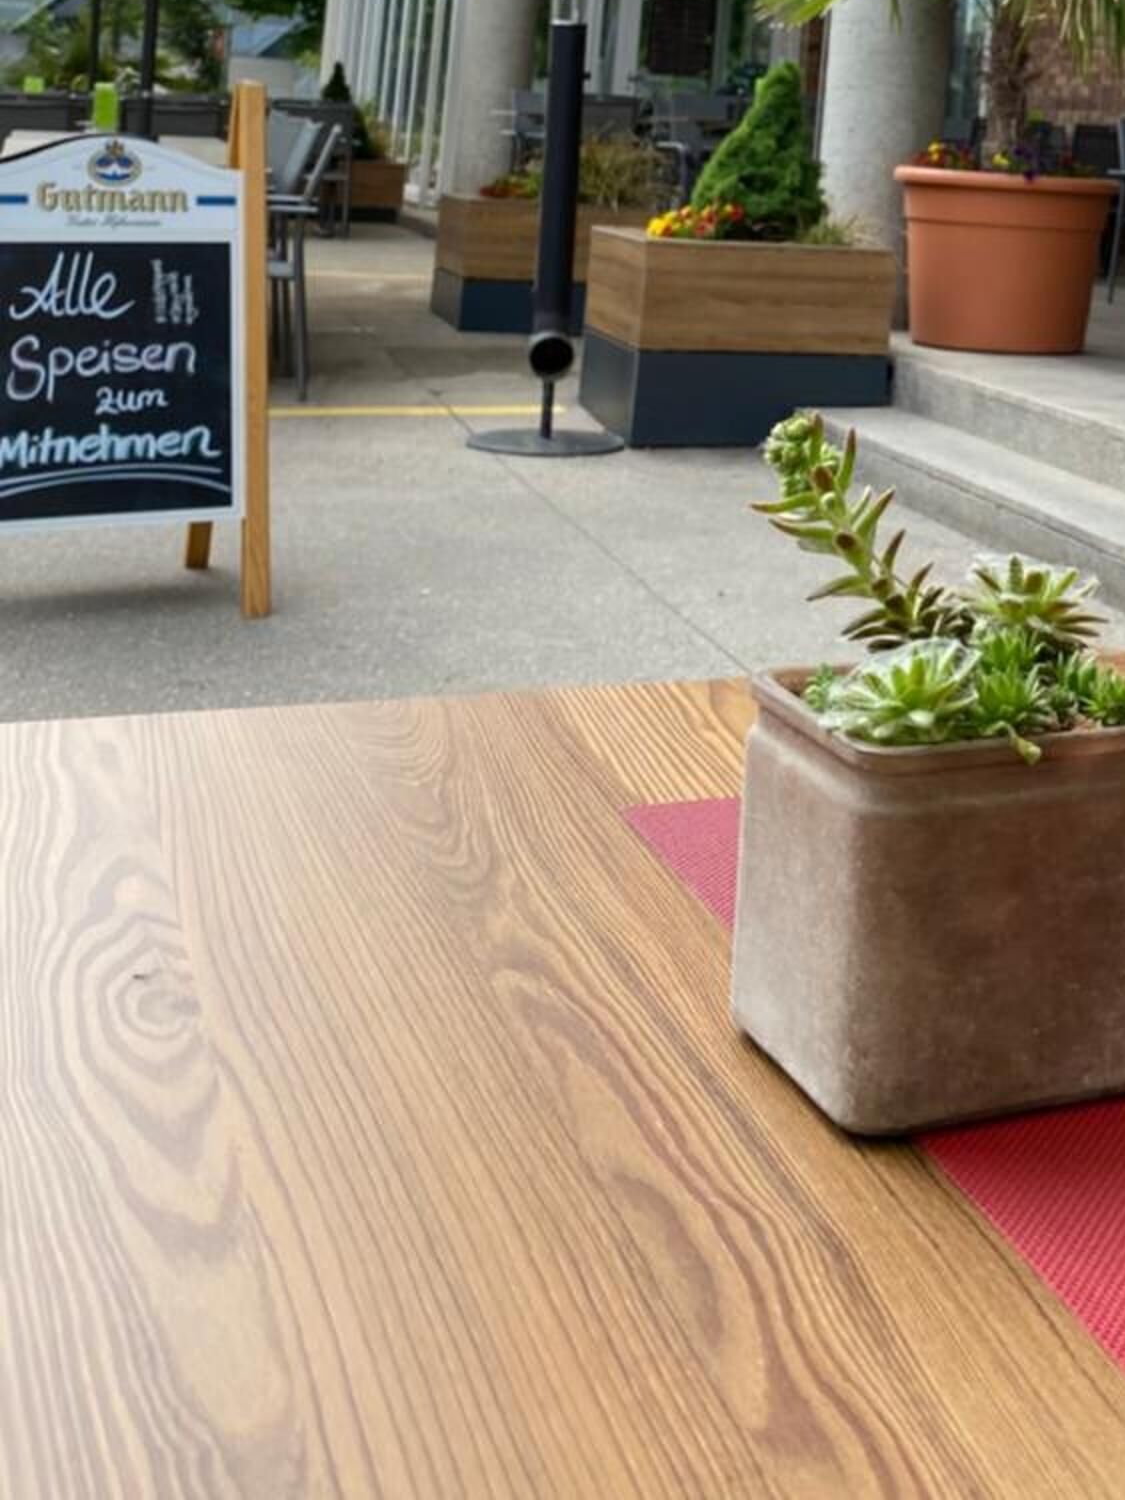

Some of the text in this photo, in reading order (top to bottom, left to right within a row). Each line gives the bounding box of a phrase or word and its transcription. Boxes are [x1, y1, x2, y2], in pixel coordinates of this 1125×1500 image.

[37, 180, 189, 213] Gutmann
[9, 250, 135, 320] Alle
[6, 334, 197, 403] Speisen
[95, 386, 168, 416] zum
[0, 422, 223, 469] Mitnehmen
